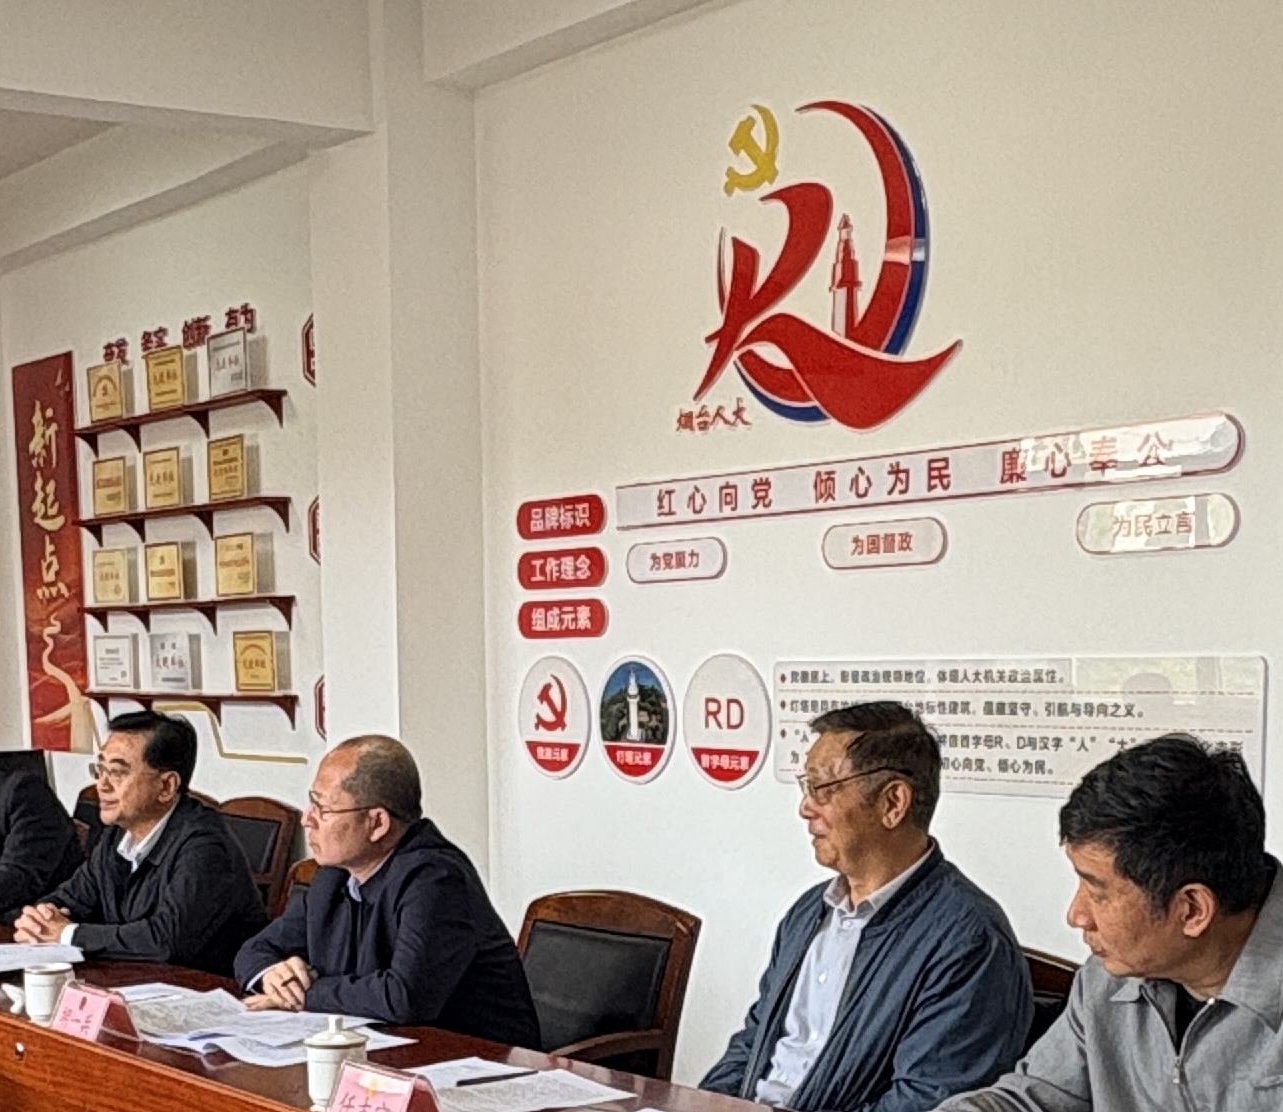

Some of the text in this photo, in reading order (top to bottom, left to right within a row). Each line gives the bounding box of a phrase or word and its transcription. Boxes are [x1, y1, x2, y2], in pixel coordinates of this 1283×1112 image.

[676, 397, 752, 432] 烟台人大
[28, 399, 69, 600] 新起点
[656, 476, 773, 518] 红心向党
[813, 456, 951, 504] 倾心为民
[531, 502, 591, 533] 品牌标识
[531, 555, 591, 582] 工作理念
[531, 605, 591, 632] 组成元素
[704, 697, 745, 730] RD
